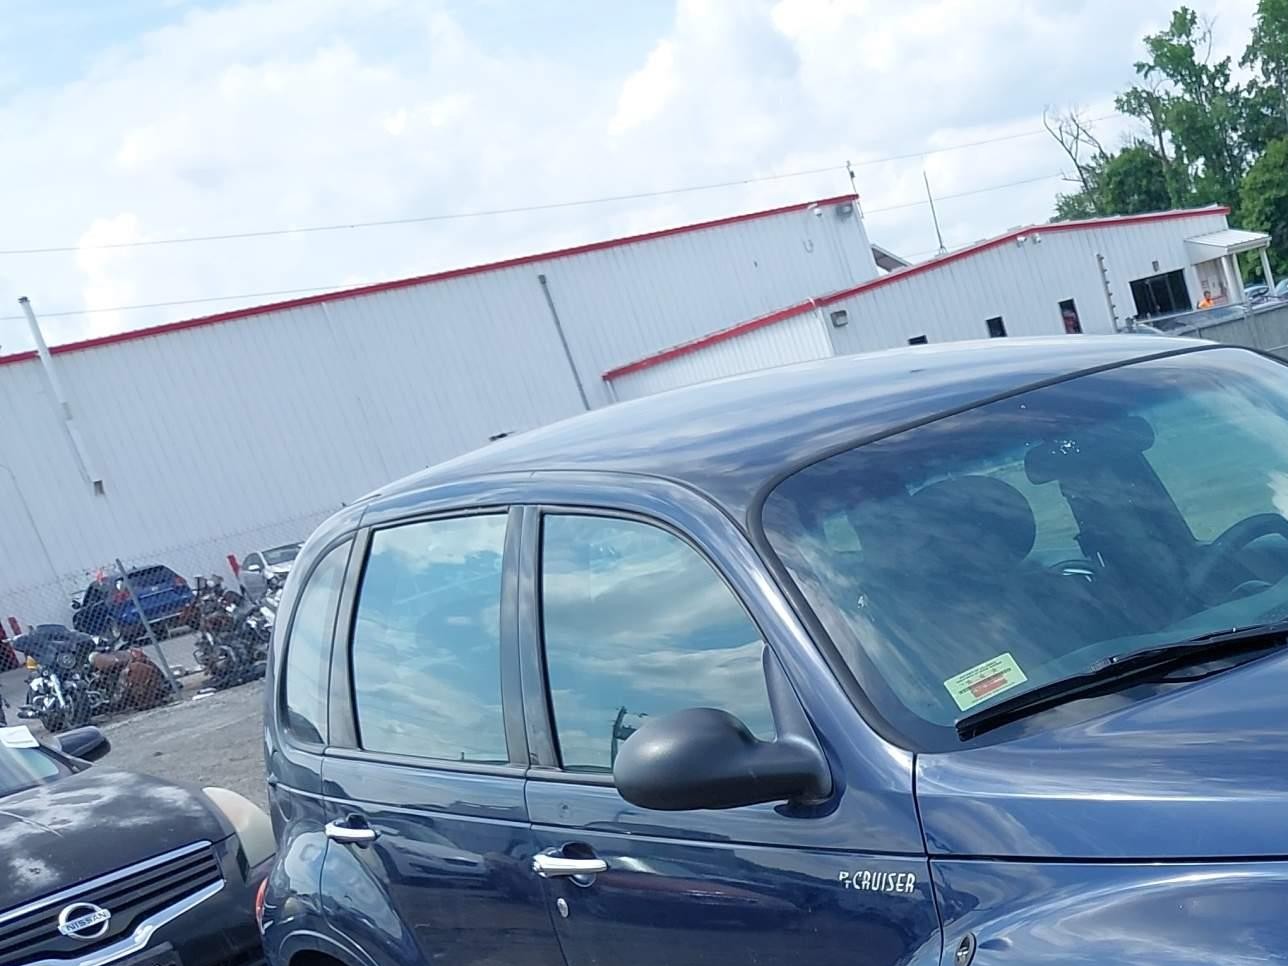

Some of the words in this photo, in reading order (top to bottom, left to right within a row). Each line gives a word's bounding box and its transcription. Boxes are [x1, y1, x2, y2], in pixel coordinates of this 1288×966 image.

[838, 871, 852, 889] PT
[852, 870, 916, 893] CRUISER
[66, 911, 107, 931] NISSAN
